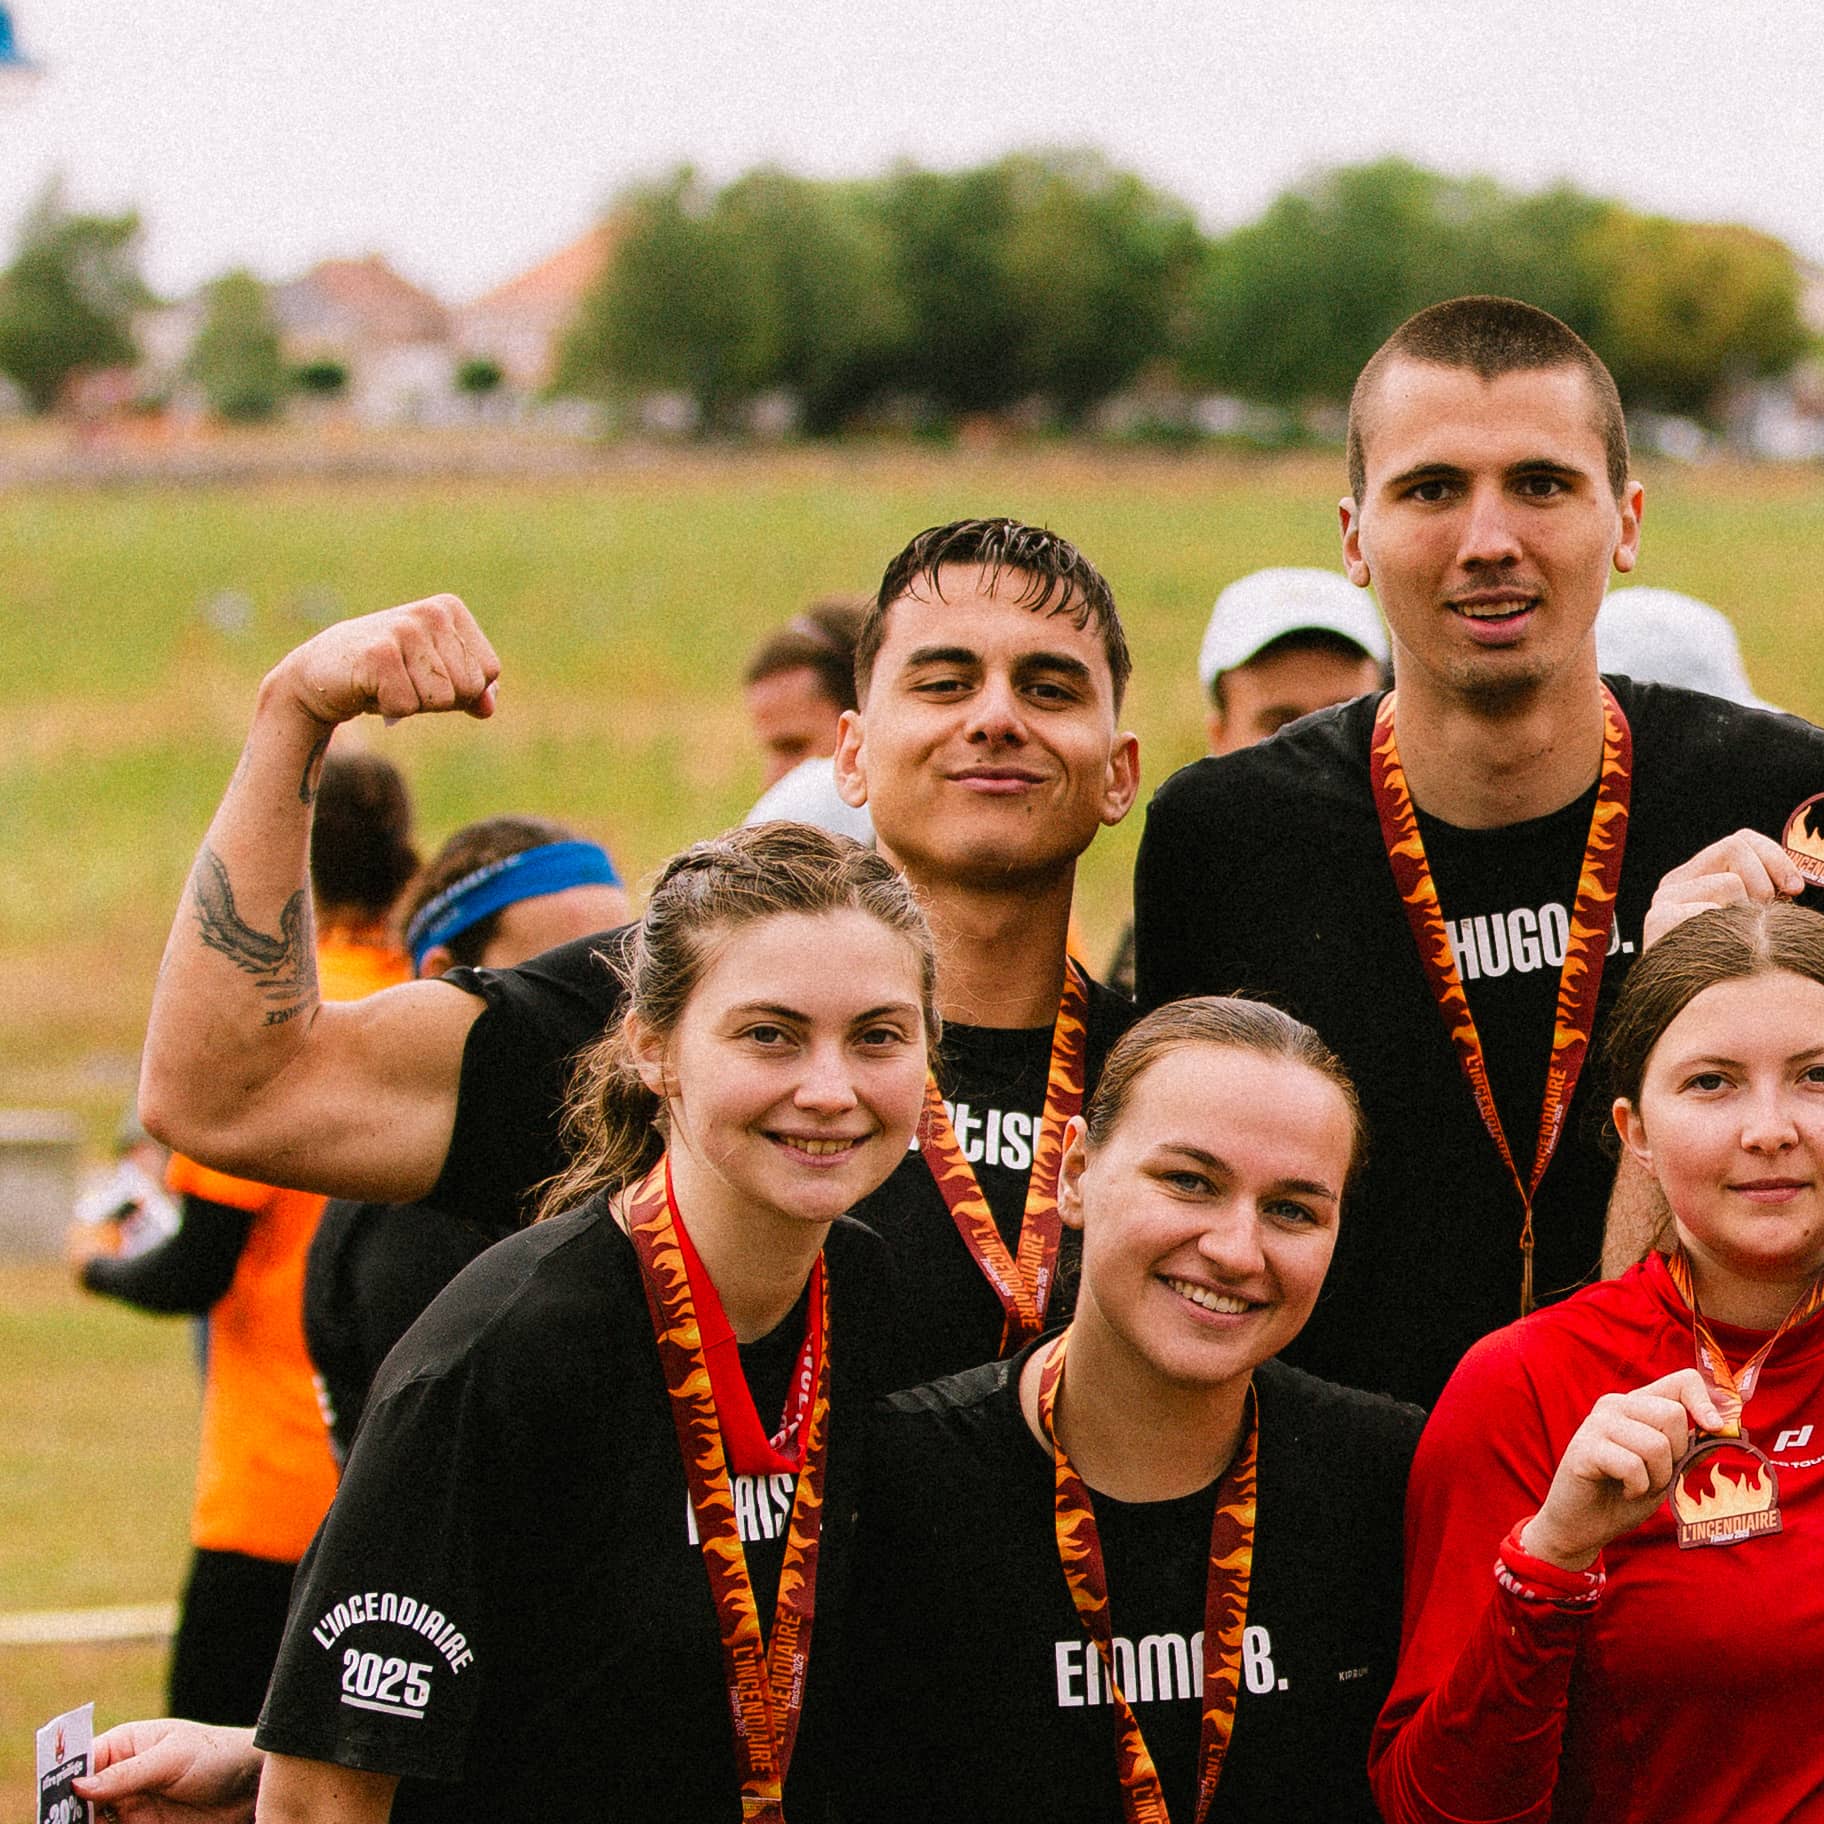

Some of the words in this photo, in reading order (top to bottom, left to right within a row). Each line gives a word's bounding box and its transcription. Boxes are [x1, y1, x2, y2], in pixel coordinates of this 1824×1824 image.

[1445, 902, 1570, 980] HUGO
[1682, 1510, 1778, 1543] L'INCENDIAIRE
[312, 1592, 474, 1675] L'INCENDIAIRE
[1242, 1625, 1289, 1694] B.
[341, 1648, 433, 1707] 2025
[732, 1645, 774, 1773] L'INCENDIAIRE
